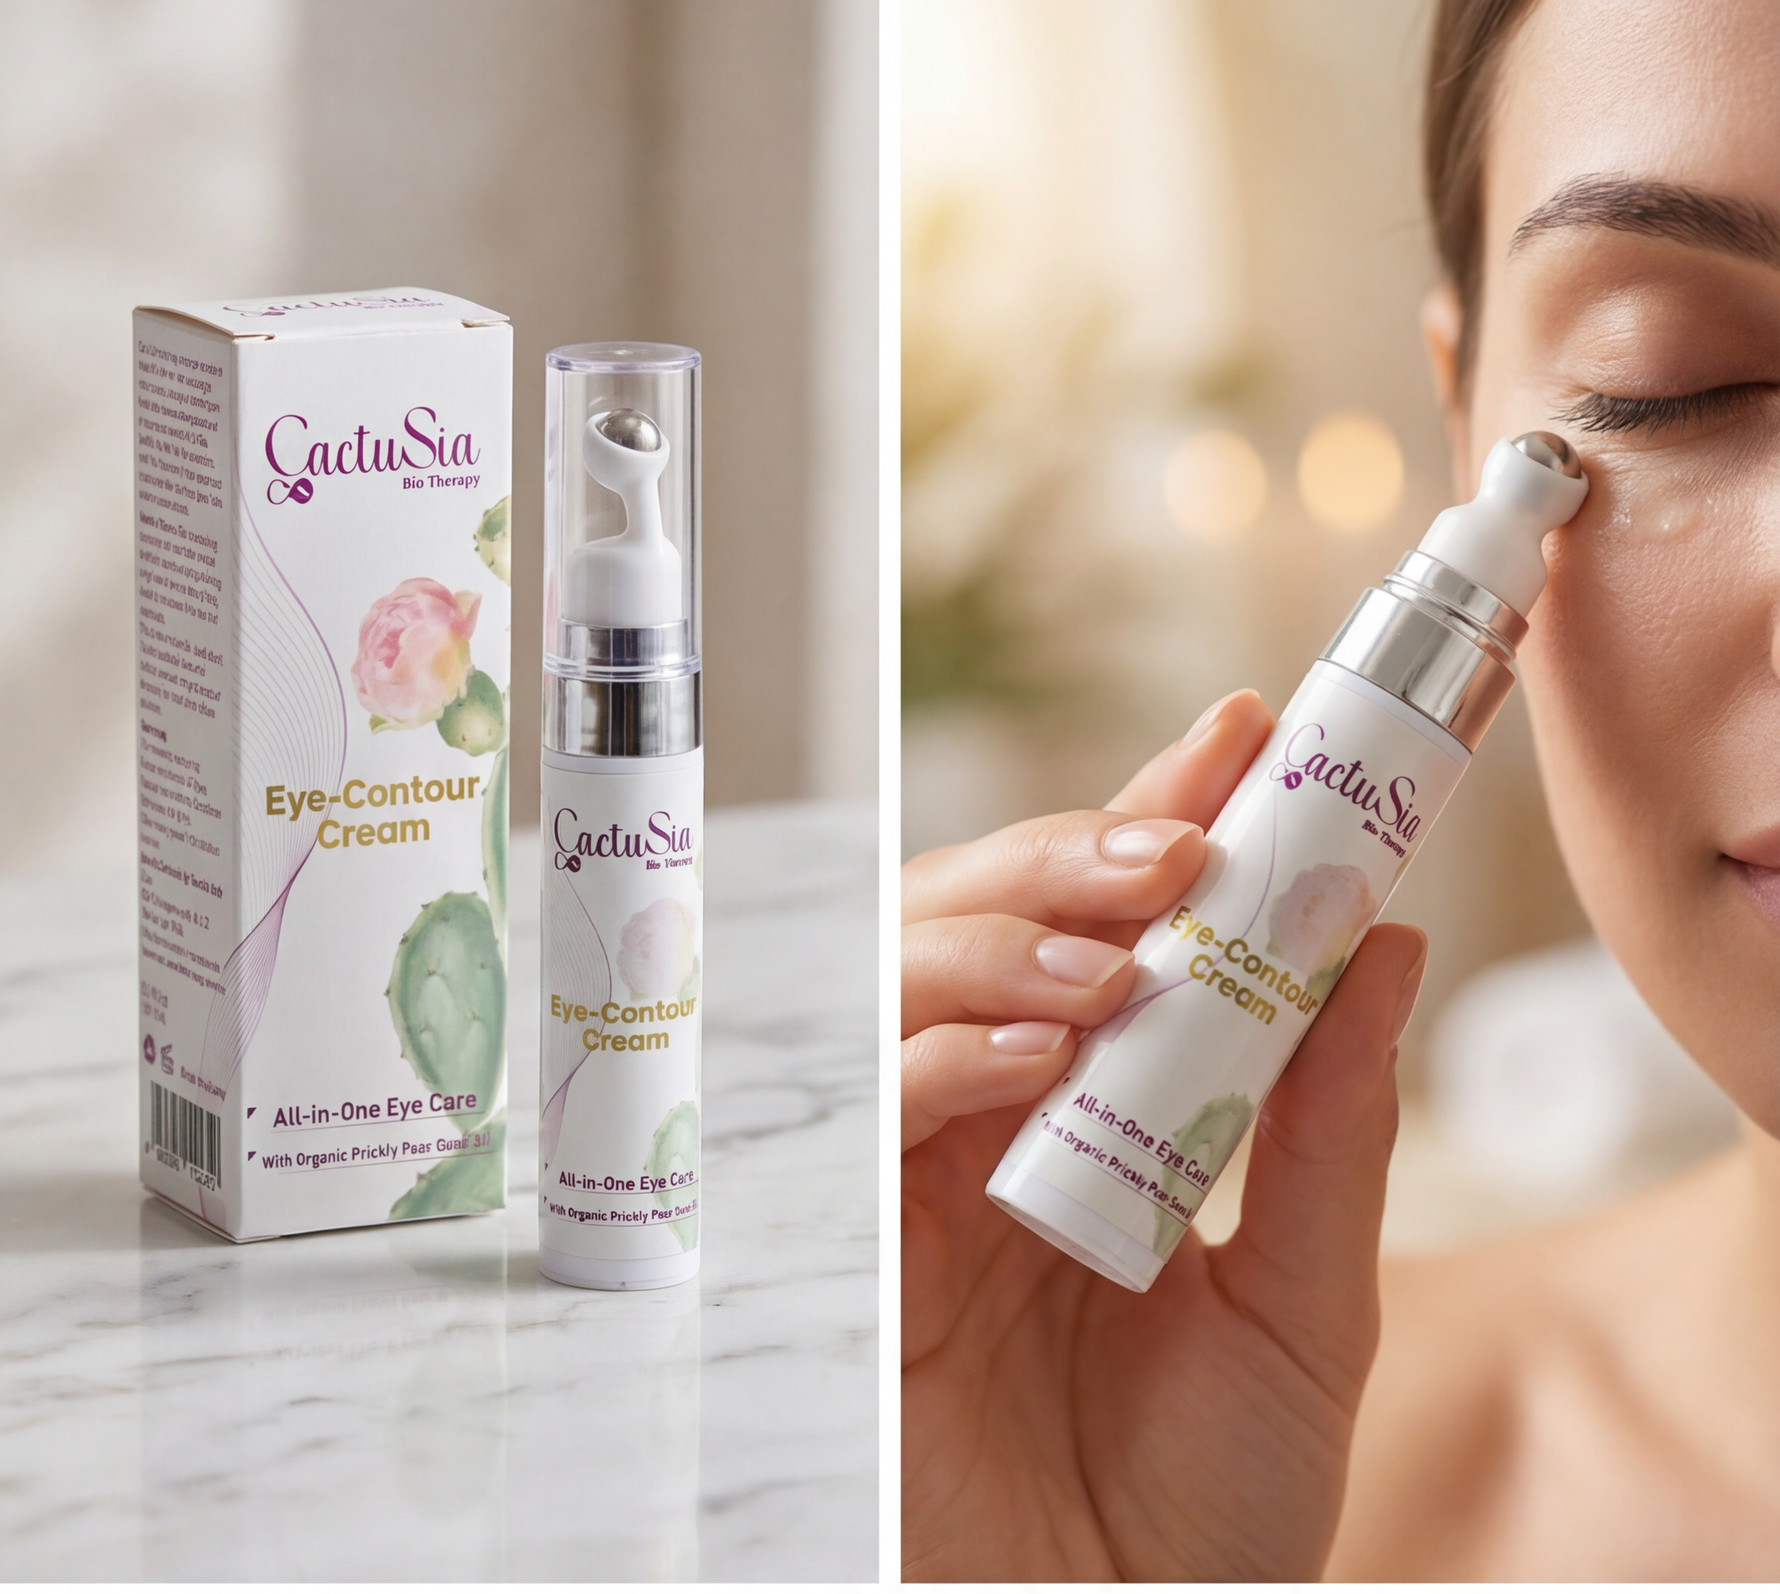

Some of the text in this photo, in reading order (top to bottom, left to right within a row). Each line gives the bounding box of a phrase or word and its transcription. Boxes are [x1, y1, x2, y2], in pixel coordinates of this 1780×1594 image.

[265, 406, 481, 477] CactuSia
[402, 475, 481, 490] Bio Therapy
[266, 775, 480, 822] Eye-Contour
[1285, 723, 1421, 843] CactuSia
[317, 818, 430, 849] Cream
[554, 807, 694, 858] CactuSia
[1169, 905, 1319, 1016] Eye-Contour
[1189, 954, 1277, 1026] Cream
[551, 993, 697, 1024] Eye-Contour
[582, 1028, 669, 1052] Cream
[273, 1093, 477, 1128] All-in-One Eye Care
[1073, 1093, 1155, 1149] All-in-One
[1155, 1140, 1184, 1169] Eye
[262, 1153, 292, 1169] With
[296, 1148, 348, 1169] Organic
[351, 1143, 398, 1161] Prickly
[559, 1170, 694, 1193] All-in-One Eye Care
[568, 1207, 608, 1222] Organic
[610, 1210, 649, 1224] Prickly
